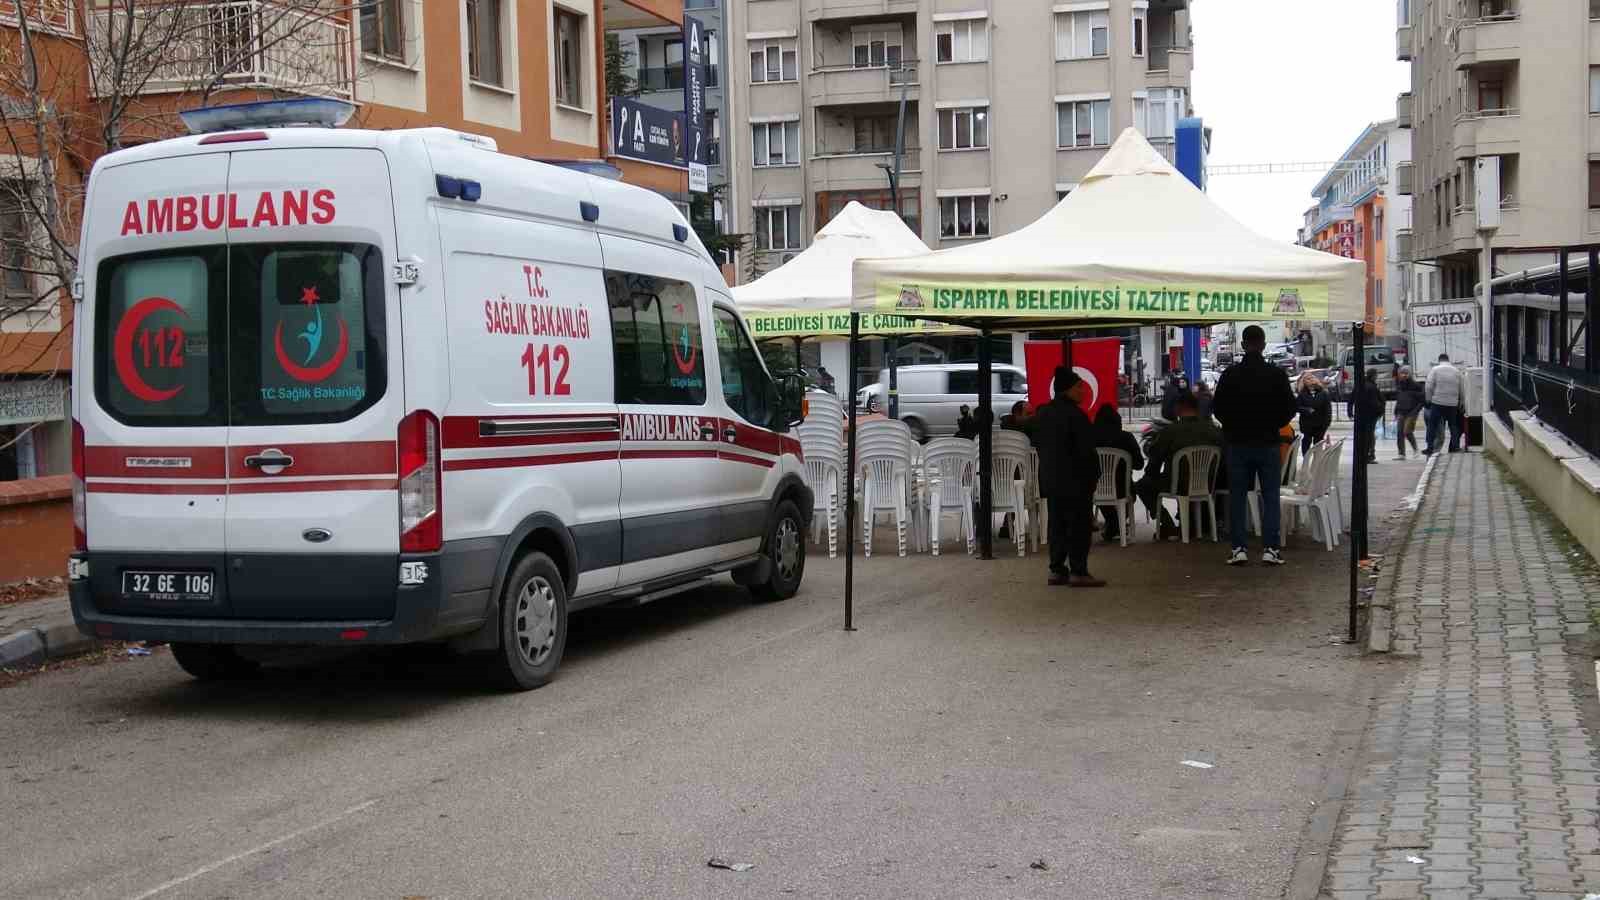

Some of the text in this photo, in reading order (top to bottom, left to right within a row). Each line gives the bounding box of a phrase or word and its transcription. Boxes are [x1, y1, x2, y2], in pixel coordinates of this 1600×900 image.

[121, 189, 336, 236] AMBULANS
[523, 265, 549, 298] T.C.
[933, 286, 1263, 315] ISPARTA BELEDİYESİ TAZİYE ÇADIRI
[485, 296, 590, 339] SAĞLIK BAKANLIĞI
[755, 312, 823, 332] BELEDİYESİ
[827, 315, 868, 330] TAZE
[139, 326, 184, 368] 112
[520, 342, 571, 396] 112
[623, 414, 701, 440] AMBULANS
[133, 575, 210, 593] 32 GE 106
